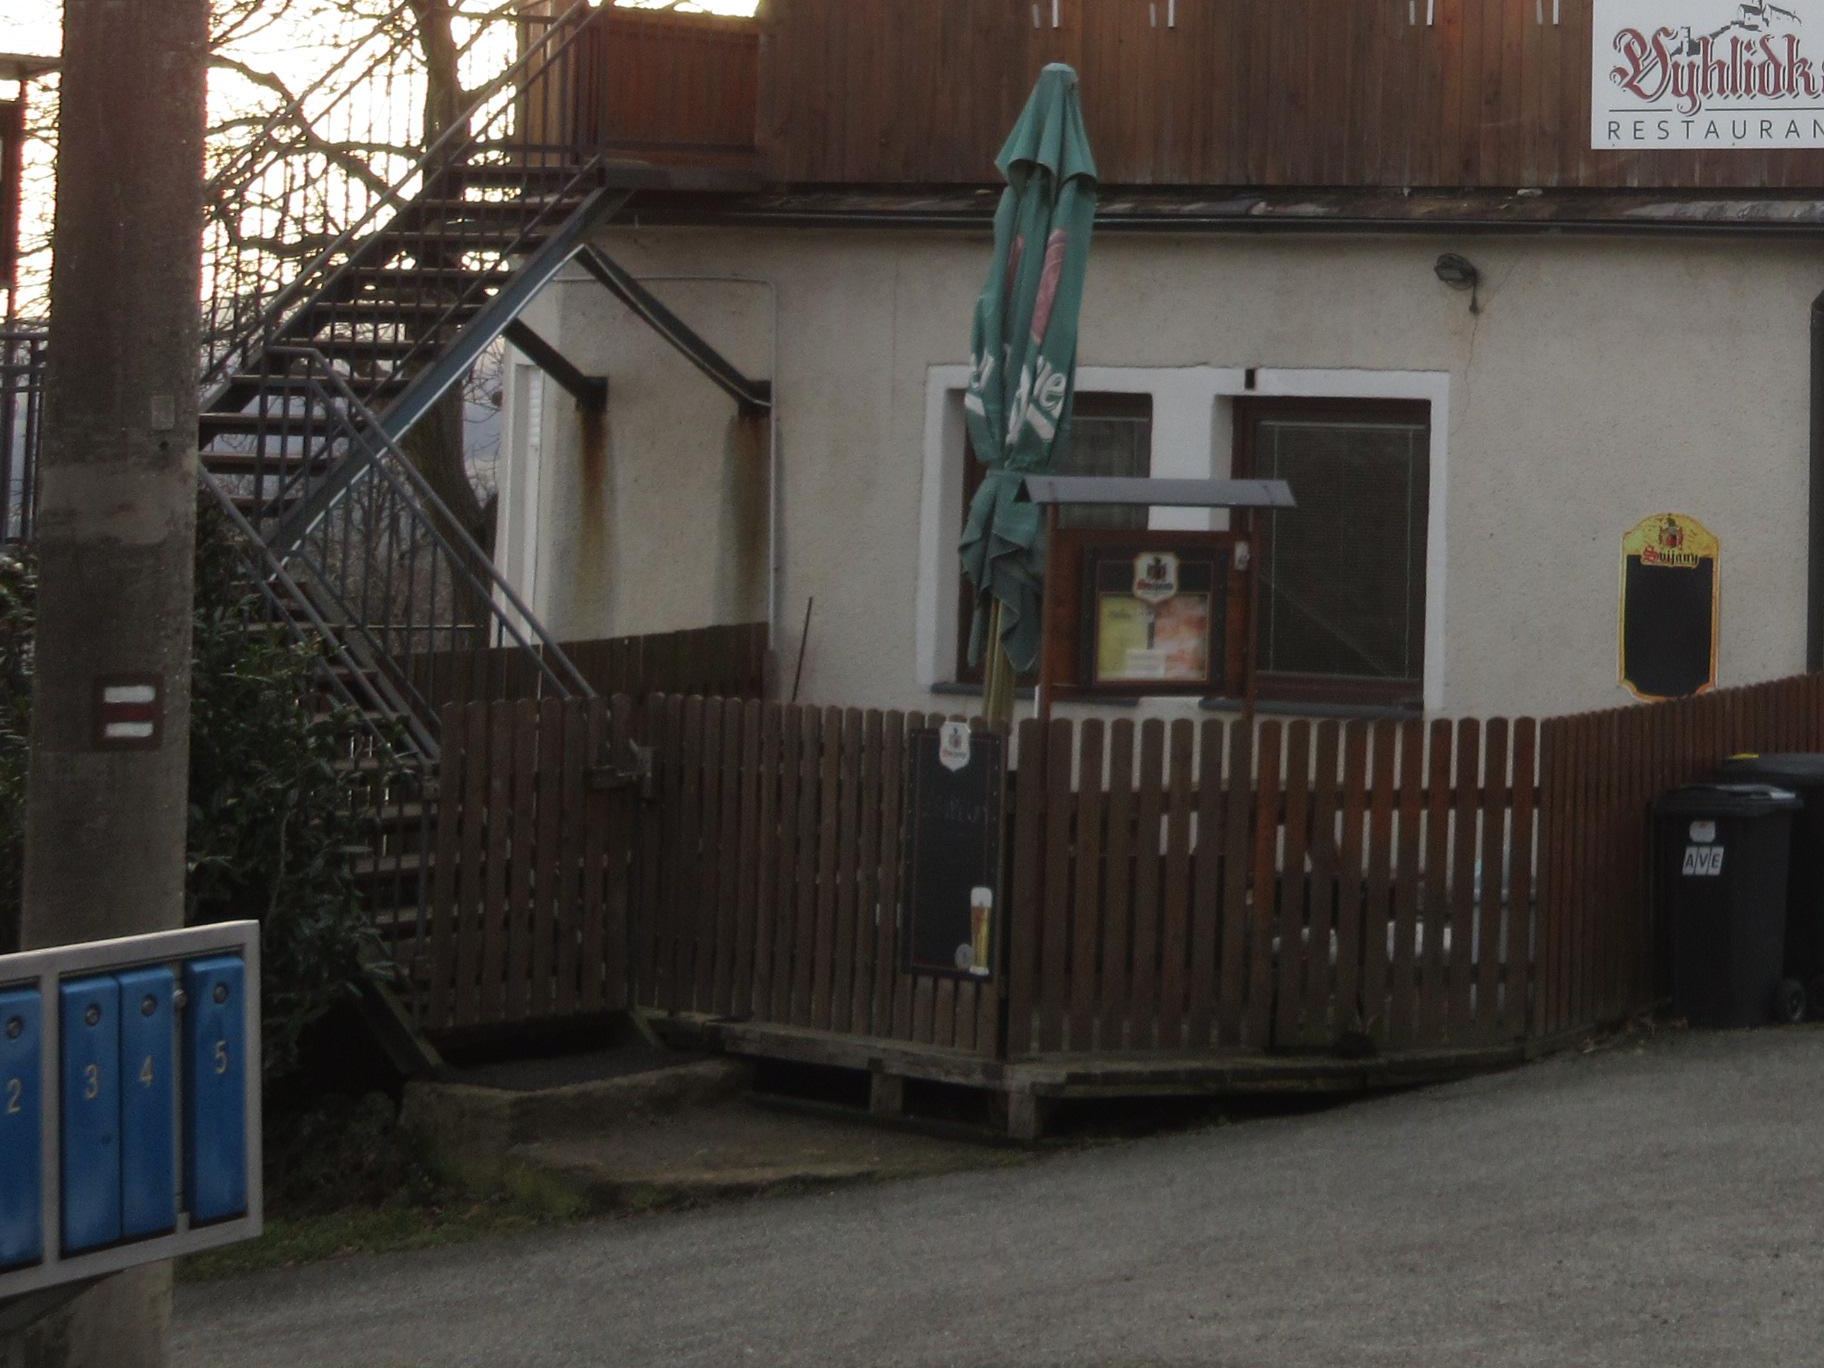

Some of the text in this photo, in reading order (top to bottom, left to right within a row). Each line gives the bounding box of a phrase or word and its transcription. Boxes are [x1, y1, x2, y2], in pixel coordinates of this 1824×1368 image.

[1642, 545, 1698, 567] Svijany
[1685, 853, 1721, 869] AVE
[138, 1054, 154, 1087] 4
[214, 1040, 228, 1074] 5
[7, 1078, 22, 1113] 2
[84, 1063, 98, 1099] 3
